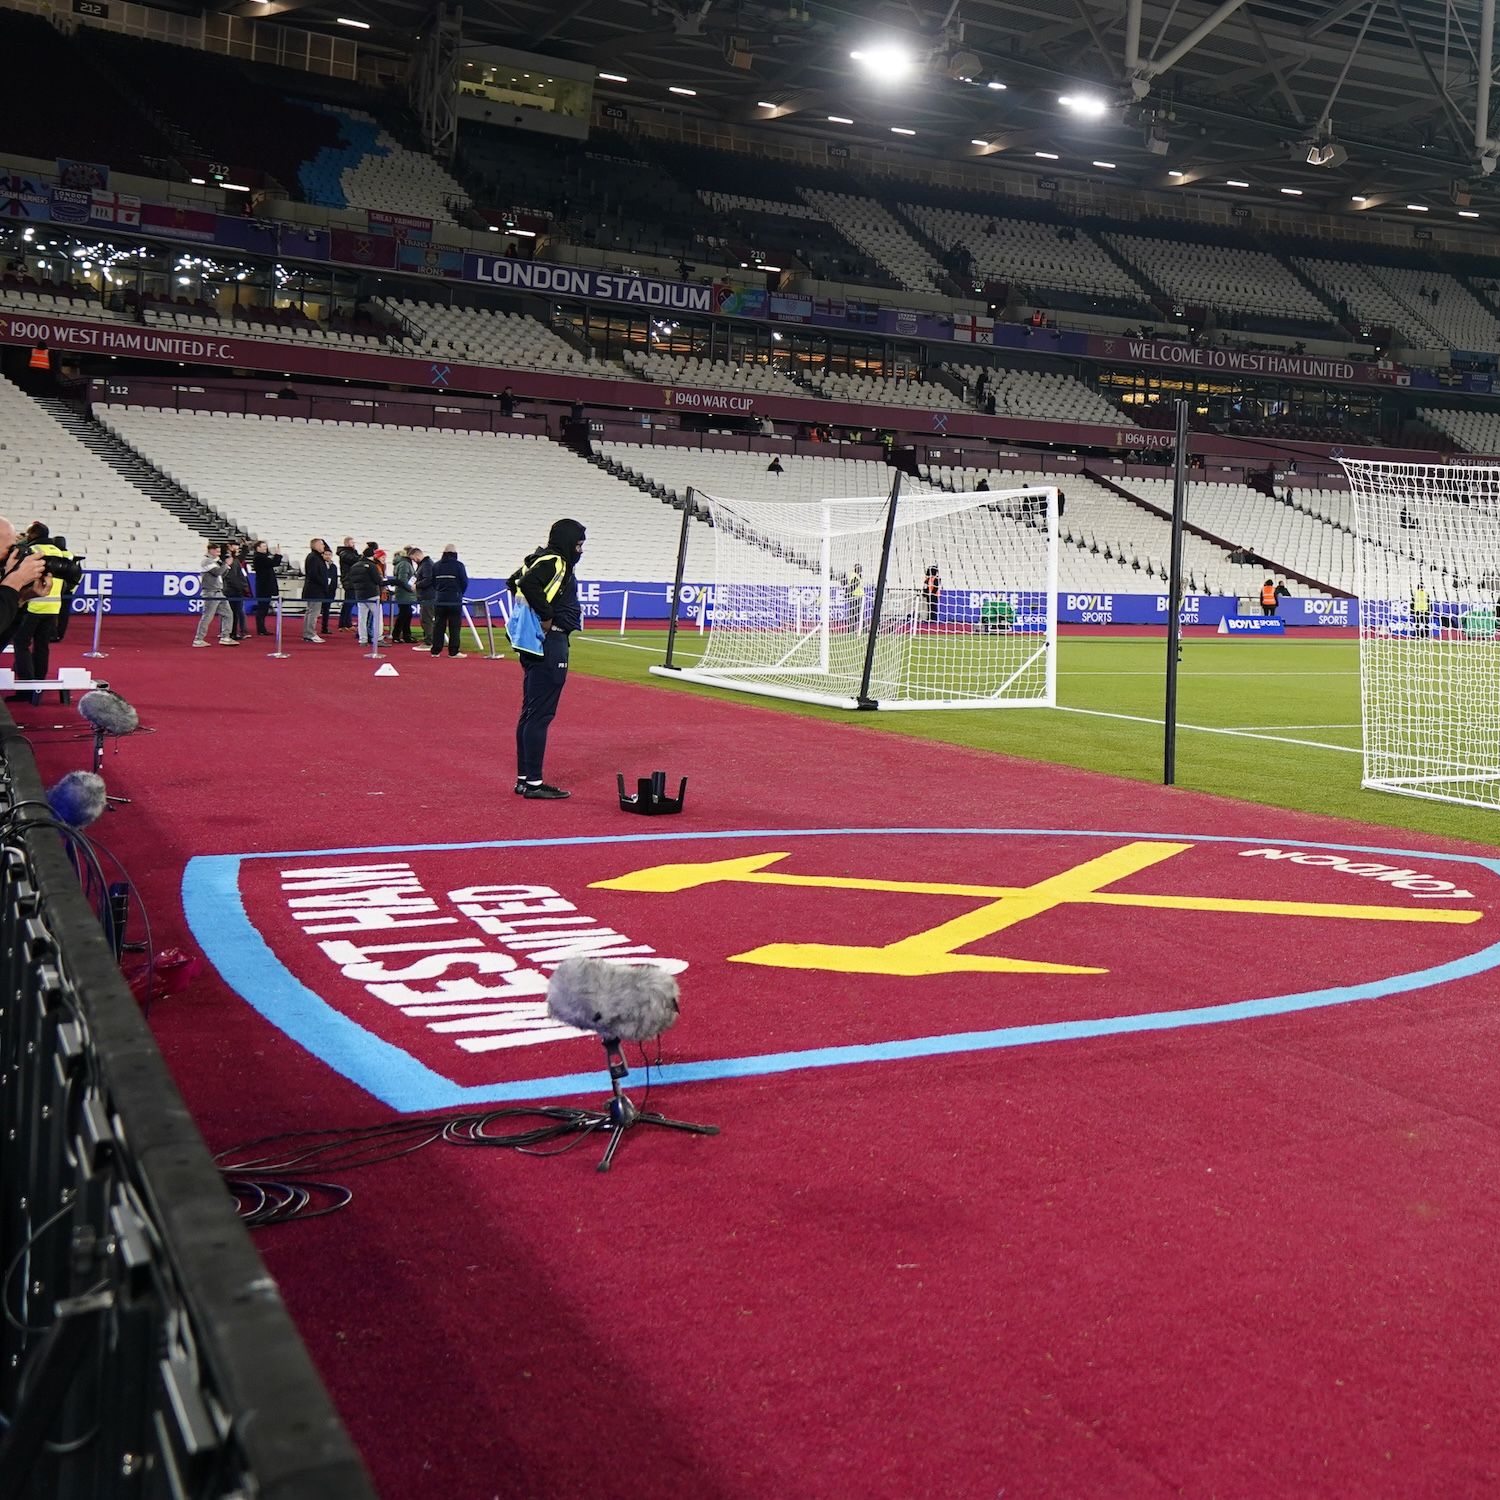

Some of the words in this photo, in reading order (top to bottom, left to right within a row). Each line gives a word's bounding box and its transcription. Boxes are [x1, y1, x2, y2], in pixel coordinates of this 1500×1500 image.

[80, 1, 102, 15] 212
[606, 107, 623, 117] 210
[209, 163, 230, 176] 212
[54, 190, 88, 200] LONDON
[54, 195, 88, 205] STADIUM
[371, 212, 392, 222] GREAT
[502, 212, 519, 223] 211
[751, 250, 766, 260] 210
[418, 266, 445, 277] IRONS
[477, 258, 590, 295] LONDON
[595, 274, 711, 311] STADIUM
[972, 280, 985, 289] 209
[10, 322, 50, 341] 1900
[52, 326, 99, 346] WEST
[102, 331, 143, 350] HAM
[144, 336, 204, 356] UNITED
[206, 344, 235, 360] F.C.
[1129, 341, 1203, 364] WELCOME
[1206, 350, 1226, 366] TO
[1227, 351, 1265, 371] WEST
[1268, 357, 1300, 376] HAM
[1302, 359, 1354, 379] UNITED
[109, 386, 129, 395] 112
[676, 392, 701, 406] 1940
[702, 395, 728, 408] WAR
[729, 397, 754, 410] CUP
[592, 423, 604, 431] 111
[1126, 433, 1145, 445] 1964
[1146, 435, 1158, 446] FA
[1066, 595, 1112, 611] BOYLE
[1304, 600, 1349, 614] BOYLE
[1081, 611, 1112, 623] SPORTS
[1318, 615, 1348, 625] SPORTS
[1227, 619, 1261, 629] BOYLE
[1237, 848, 1476, 899] LONDON
[280, 862, 458, 935] HAM
[317, 937, 598, 1053] WEST
